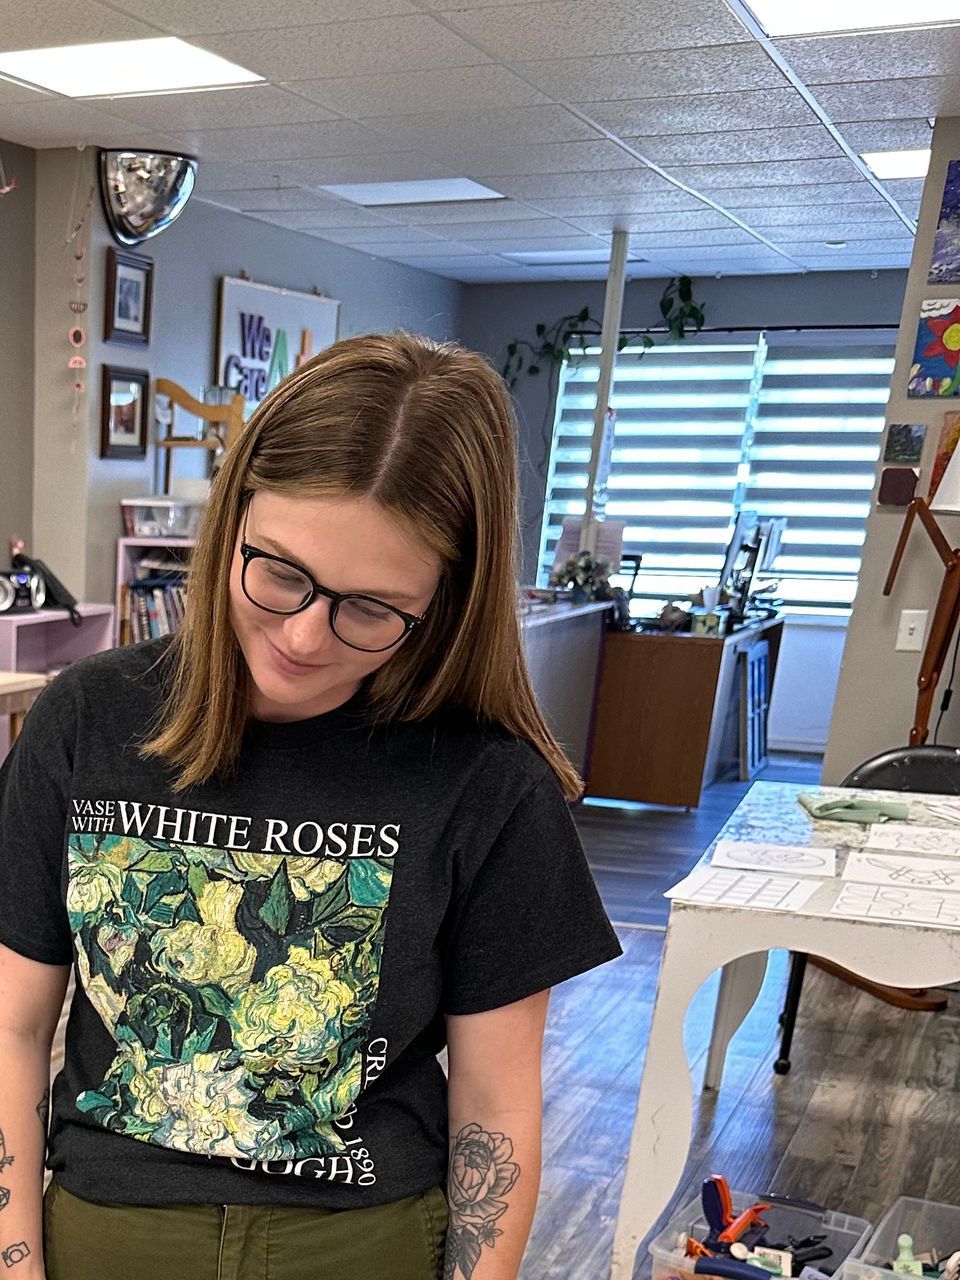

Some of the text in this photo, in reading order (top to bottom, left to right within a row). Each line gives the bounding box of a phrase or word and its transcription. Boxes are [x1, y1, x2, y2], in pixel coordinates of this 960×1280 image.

[239, 311, 271, 362] We
[224, 354, 268, 402] Care
[72, 800, 115, 816] VASE
[72, 817, 115, 832] WITH
[117, 800, 401, 858] WHITE ROSES
[343, 1136, 377, 1187] 1890
